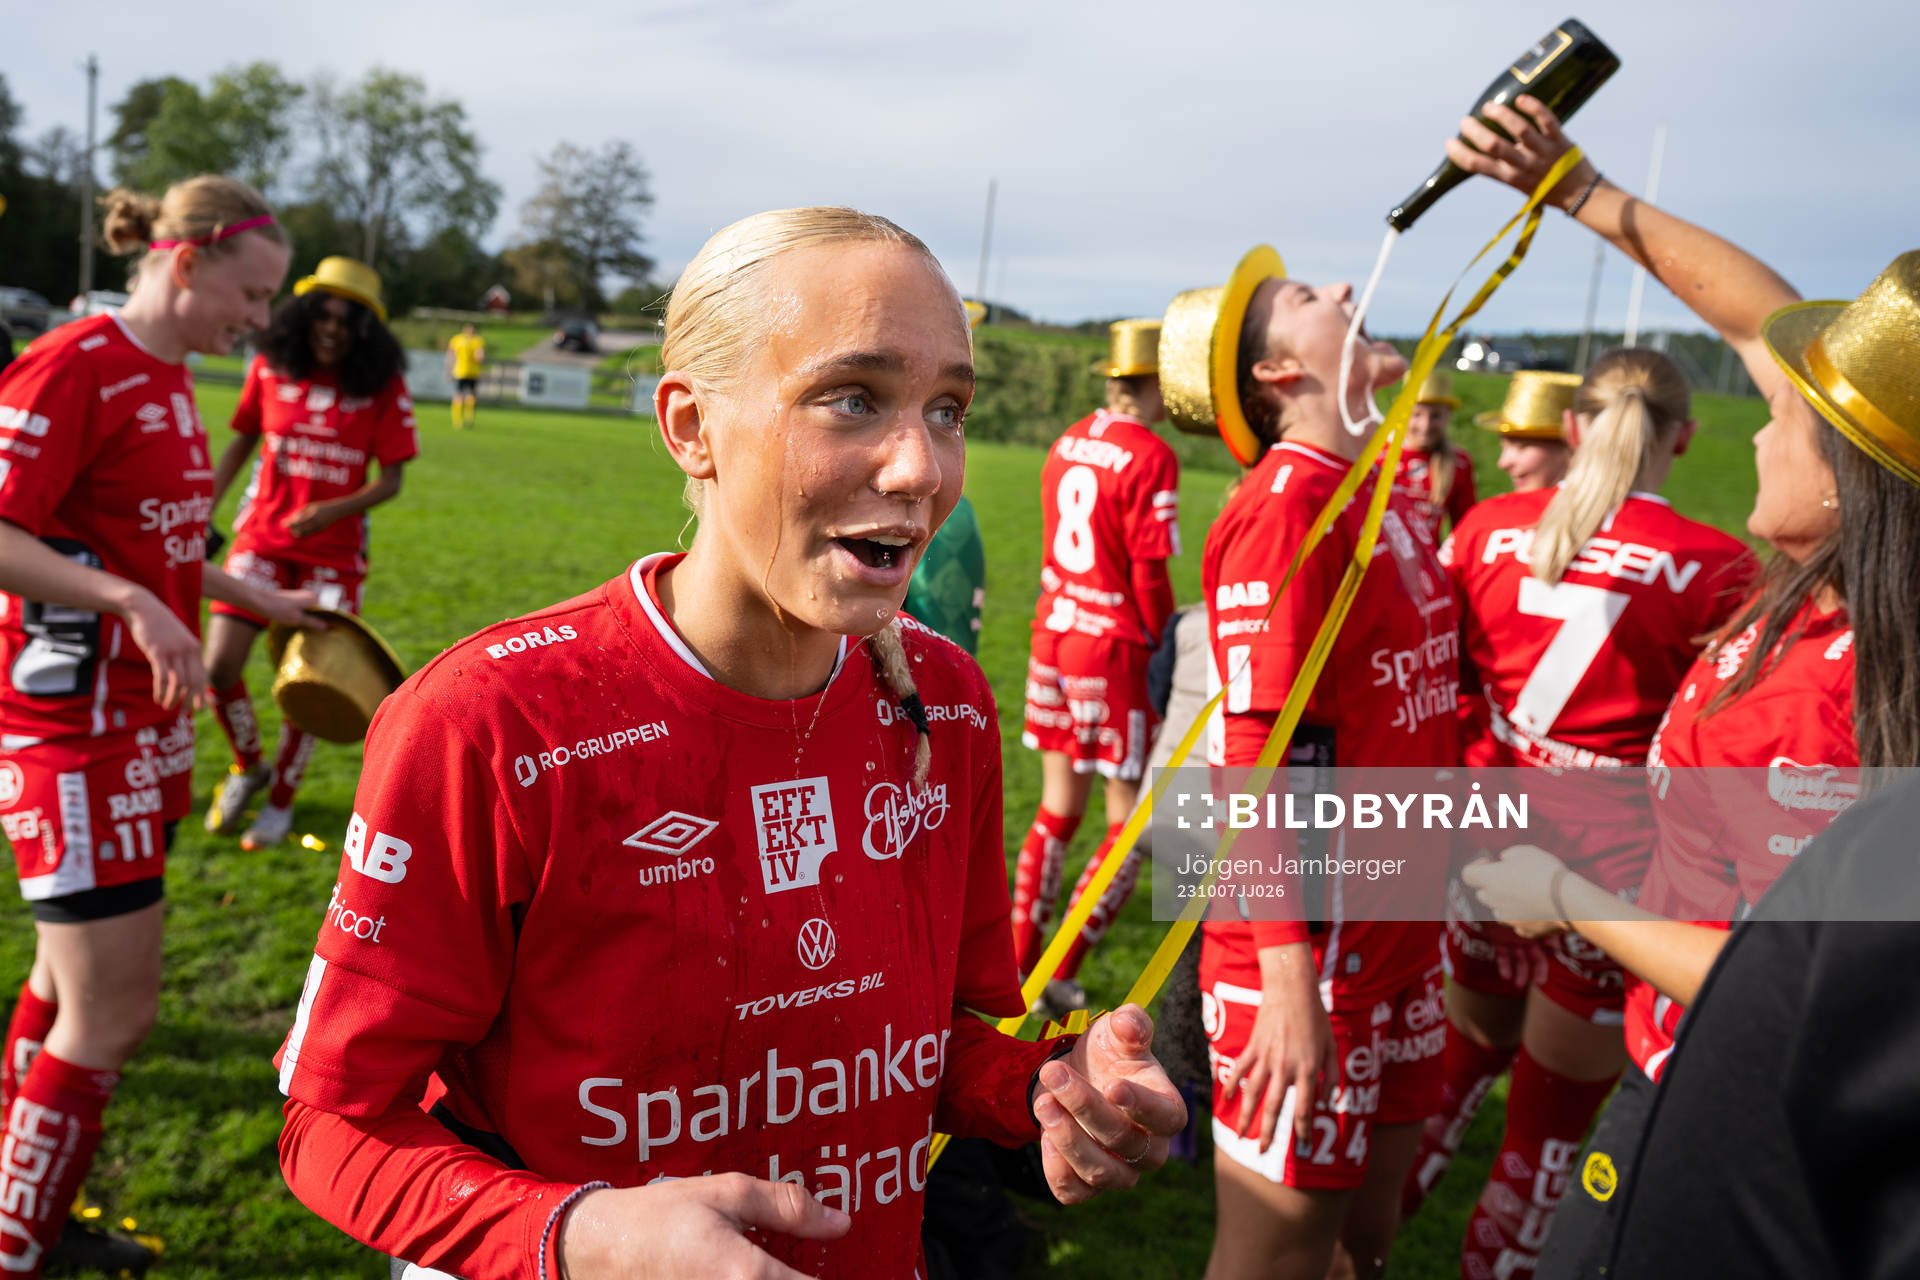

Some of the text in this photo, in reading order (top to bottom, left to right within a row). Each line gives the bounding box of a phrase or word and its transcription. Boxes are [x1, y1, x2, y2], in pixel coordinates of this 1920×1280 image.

[1053, 464, 1099, 574] 8
[486, 625, 578, 659] BORÅS
[1508, 576, 1632, 738] 7
[538, 720, 670, 772] RO-GRUPPEN
[759, 785, 817, 823] EFF
[862, 780, 951, 861] Elfsborg
[765, 815, 828, 853] EKT
[639, 855, 715, 886] umbro
[735, 971, 885, 1021] TOVEKS BIL
[1311, 1115, 1369, 1167] 24
